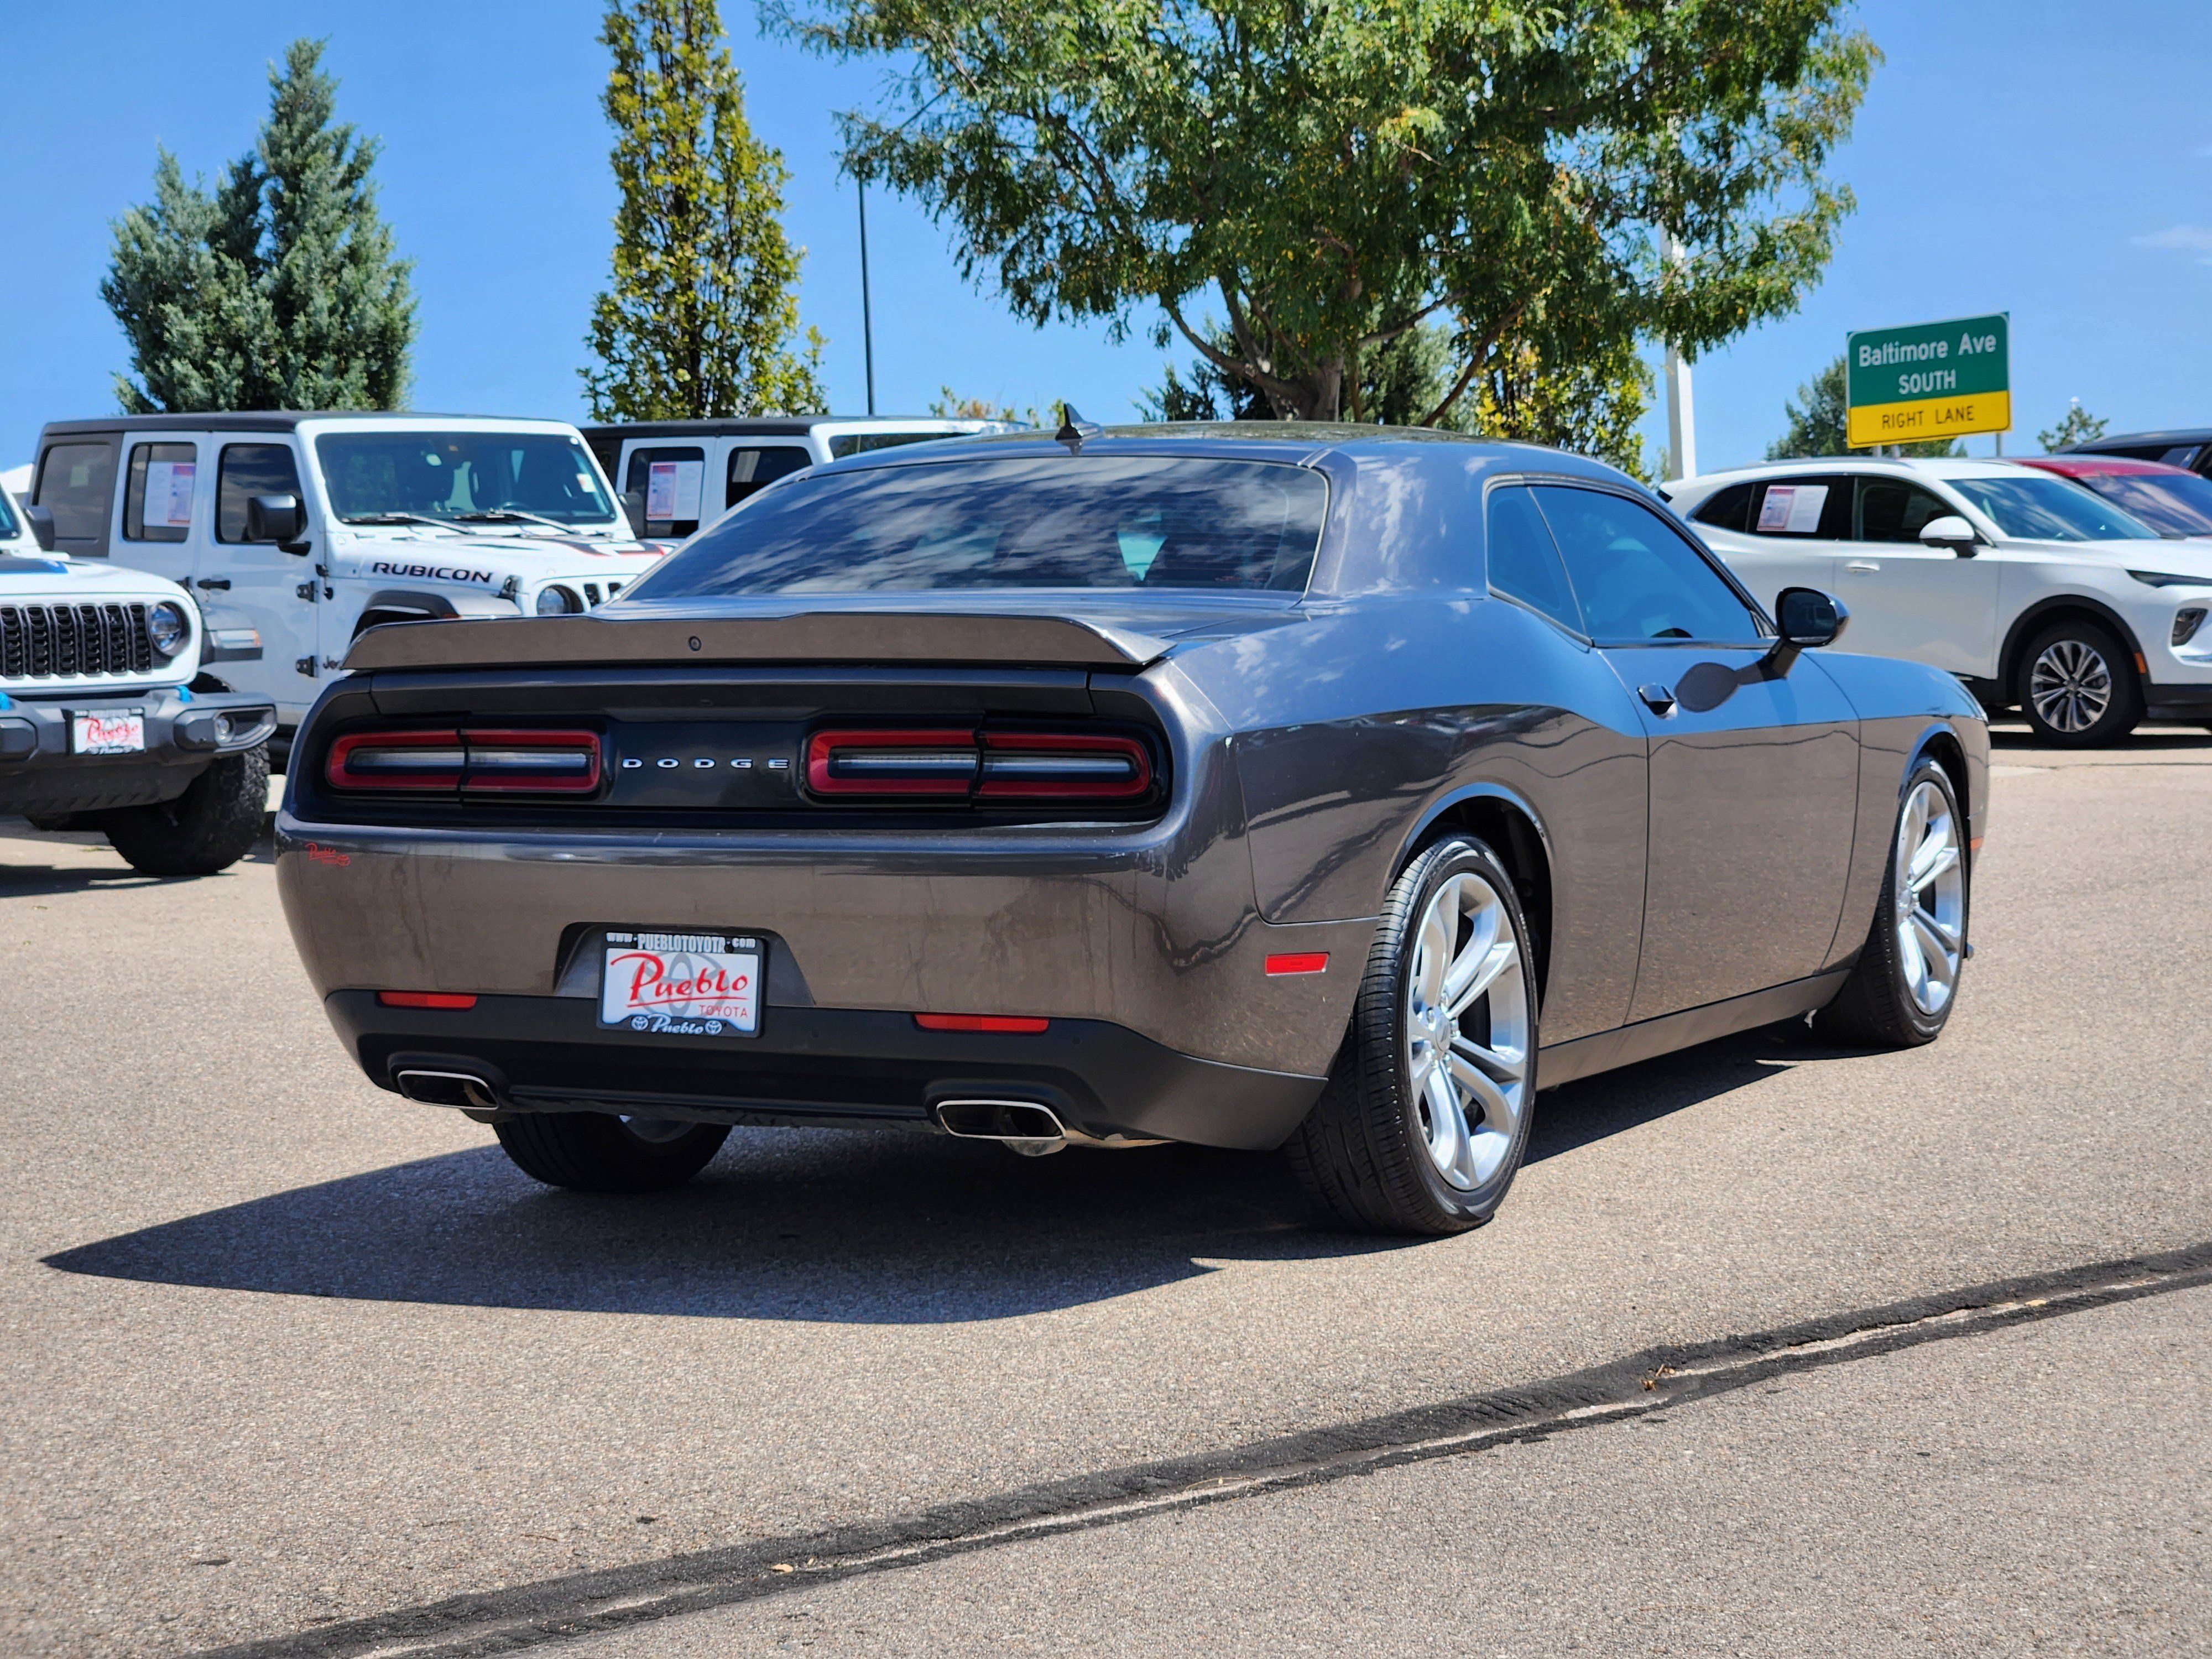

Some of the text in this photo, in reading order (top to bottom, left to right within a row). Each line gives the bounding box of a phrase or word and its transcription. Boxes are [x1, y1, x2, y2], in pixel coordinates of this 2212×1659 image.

[1859, 332, 1997, 368] Baltimore Ave
[1898, 369, 1956, 395] SOUTH
[1882, 405, 1975, 430] RIGHT LANE
[372, 562, 493, 583] RUBICON
[622, 758, 790, 769] DODGE
[610, 952, 749, 1000] Pueblo
[699, 1004, 749, 1018] TOYOTA
[648, 1013, 704, 1035] Pueblo
